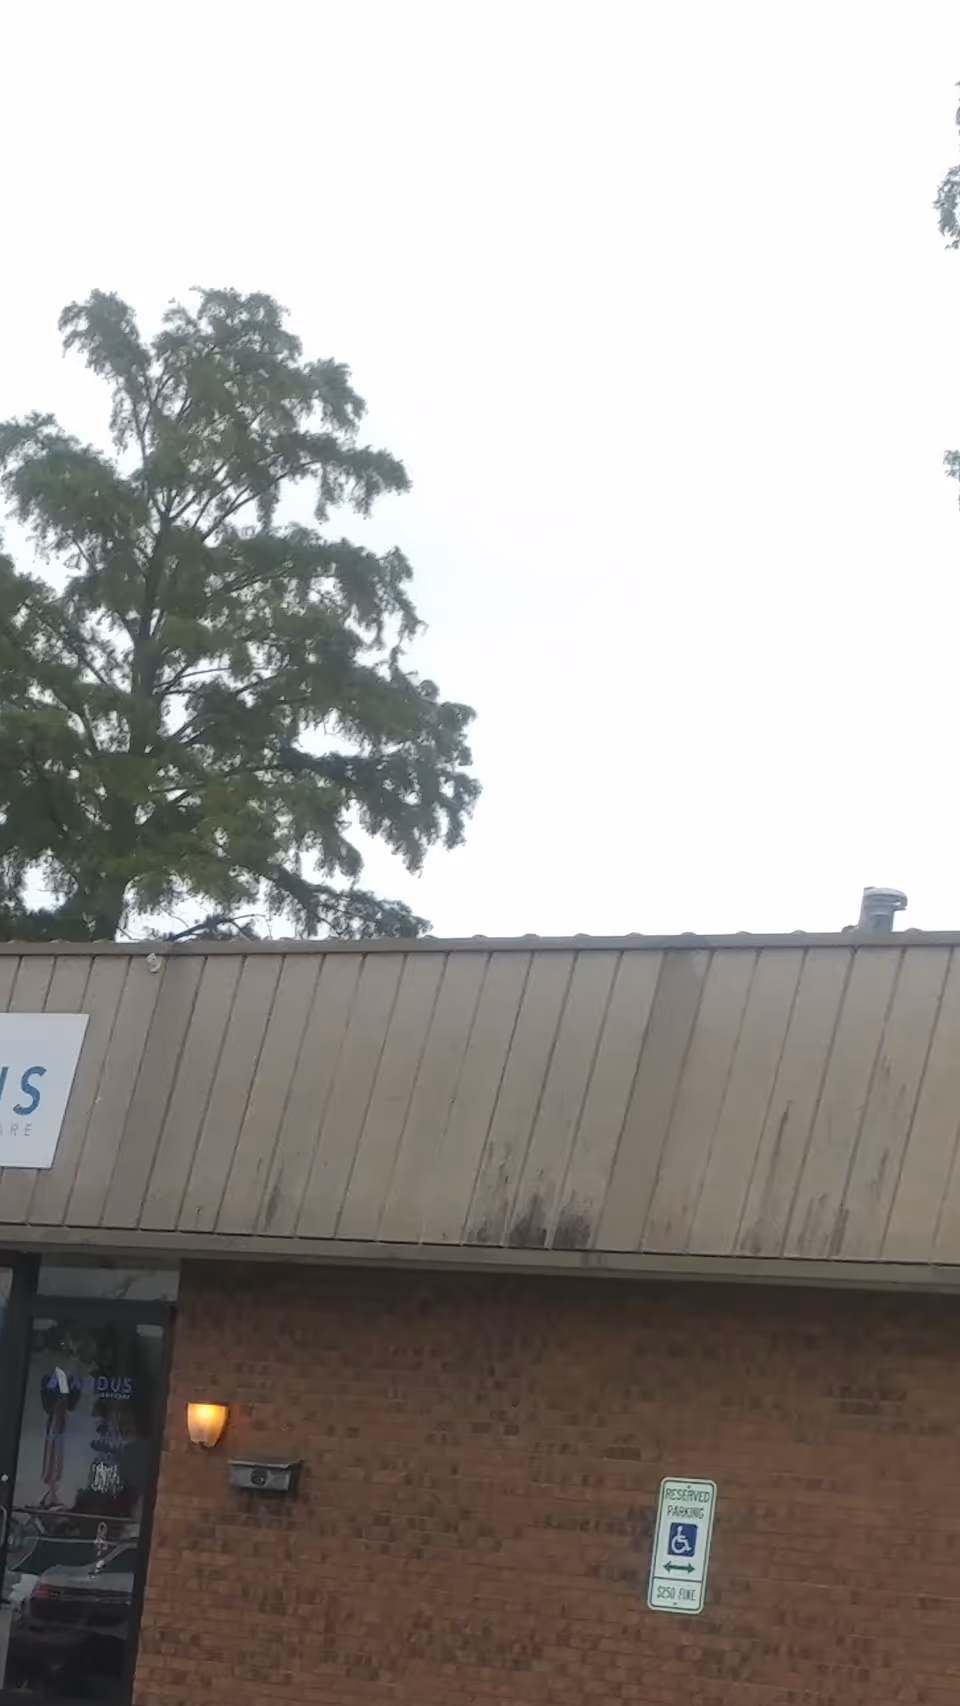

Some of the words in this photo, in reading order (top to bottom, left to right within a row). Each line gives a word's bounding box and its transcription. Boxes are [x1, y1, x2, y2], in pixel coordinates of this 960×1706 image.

[665, 1487, 711, 1504] RESERVED
[666, 1504, 705, 1520] PARKING
[656, 1584, 676, 1600] $250
[678, 1587, 697, 1601] FINE
